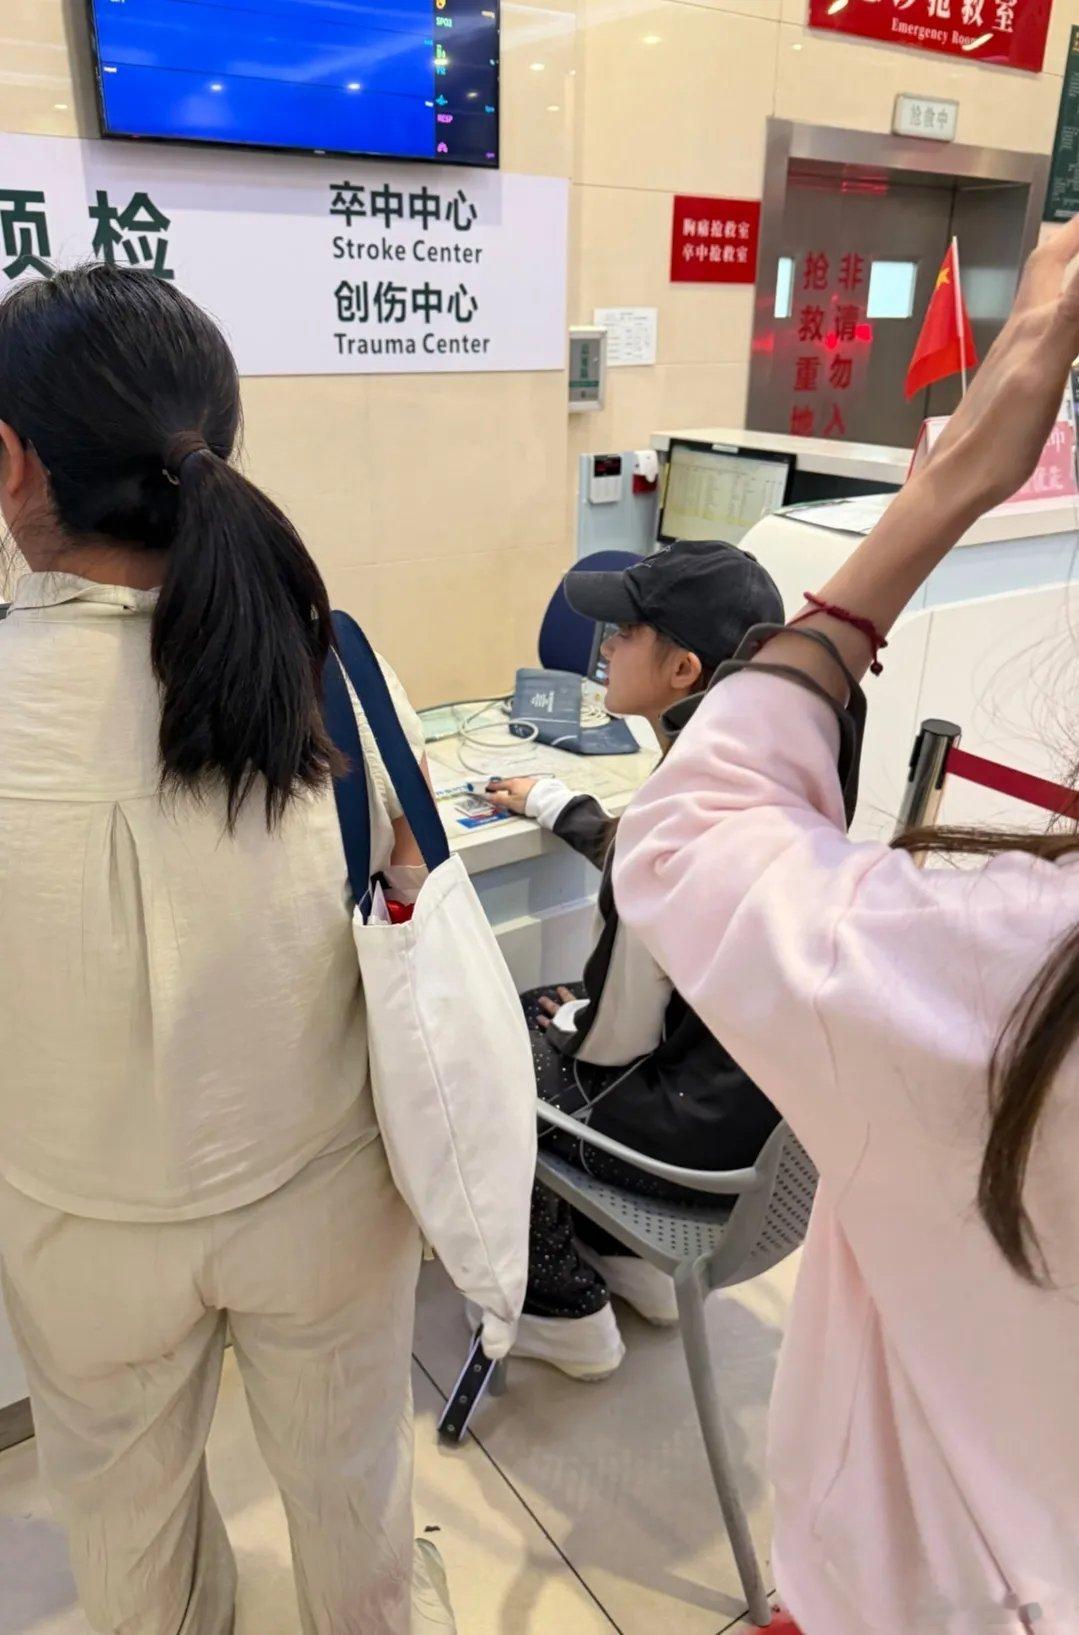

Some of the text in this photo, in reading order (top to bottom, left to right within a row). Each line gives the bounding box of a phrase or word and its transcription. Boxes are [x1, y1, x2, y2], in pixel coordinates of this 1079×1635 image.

[891, 17, 948, 44] Emergency
[329, 180, 478, 231] 卒中中心
[333, 235, 483, 264] Stroke Center
[682, 243, 749, 264] 卒中抢救室
[334, 279, 478, 324] 创伤中心
[334, 332, 490, 355] Trauma Center
